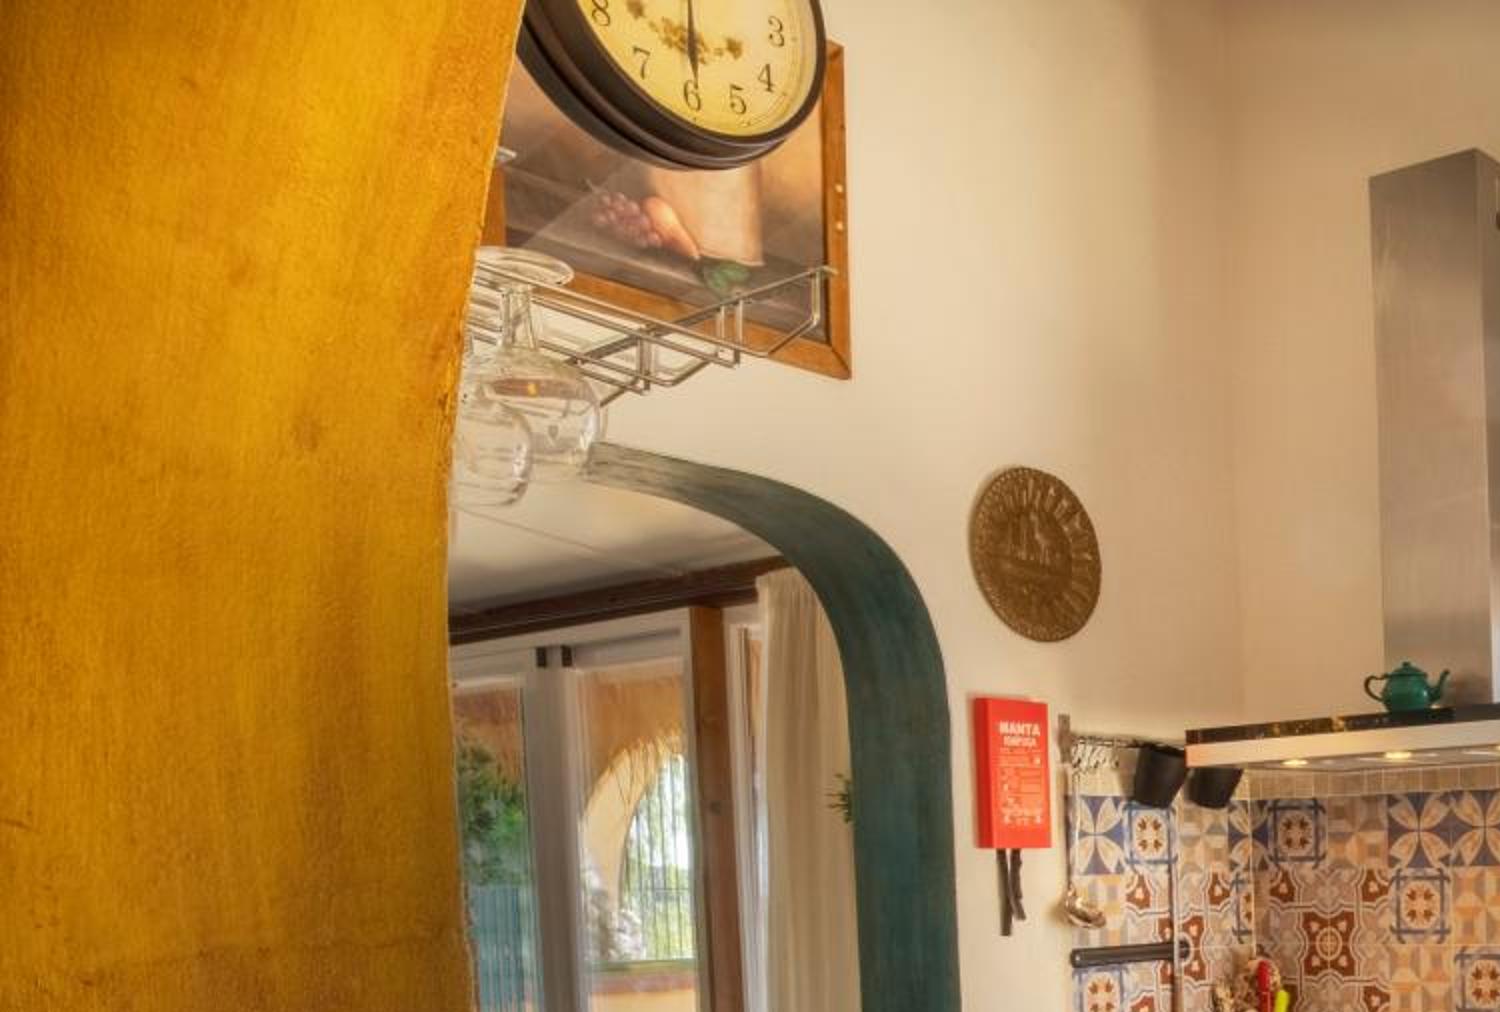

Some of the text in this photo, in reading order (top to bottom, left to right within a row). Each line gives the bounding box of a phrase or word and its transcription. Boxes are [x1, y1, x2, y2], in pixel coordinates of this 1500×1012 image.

[768, 16, 785, 47] 3
[633, 47, 651, 79] 7
[757, 63, 776, 93] 4
[683, 79, 702, 112] 6
[729, 84, 747, 115] 5
[999, 721, 1041, 737] MANTA
